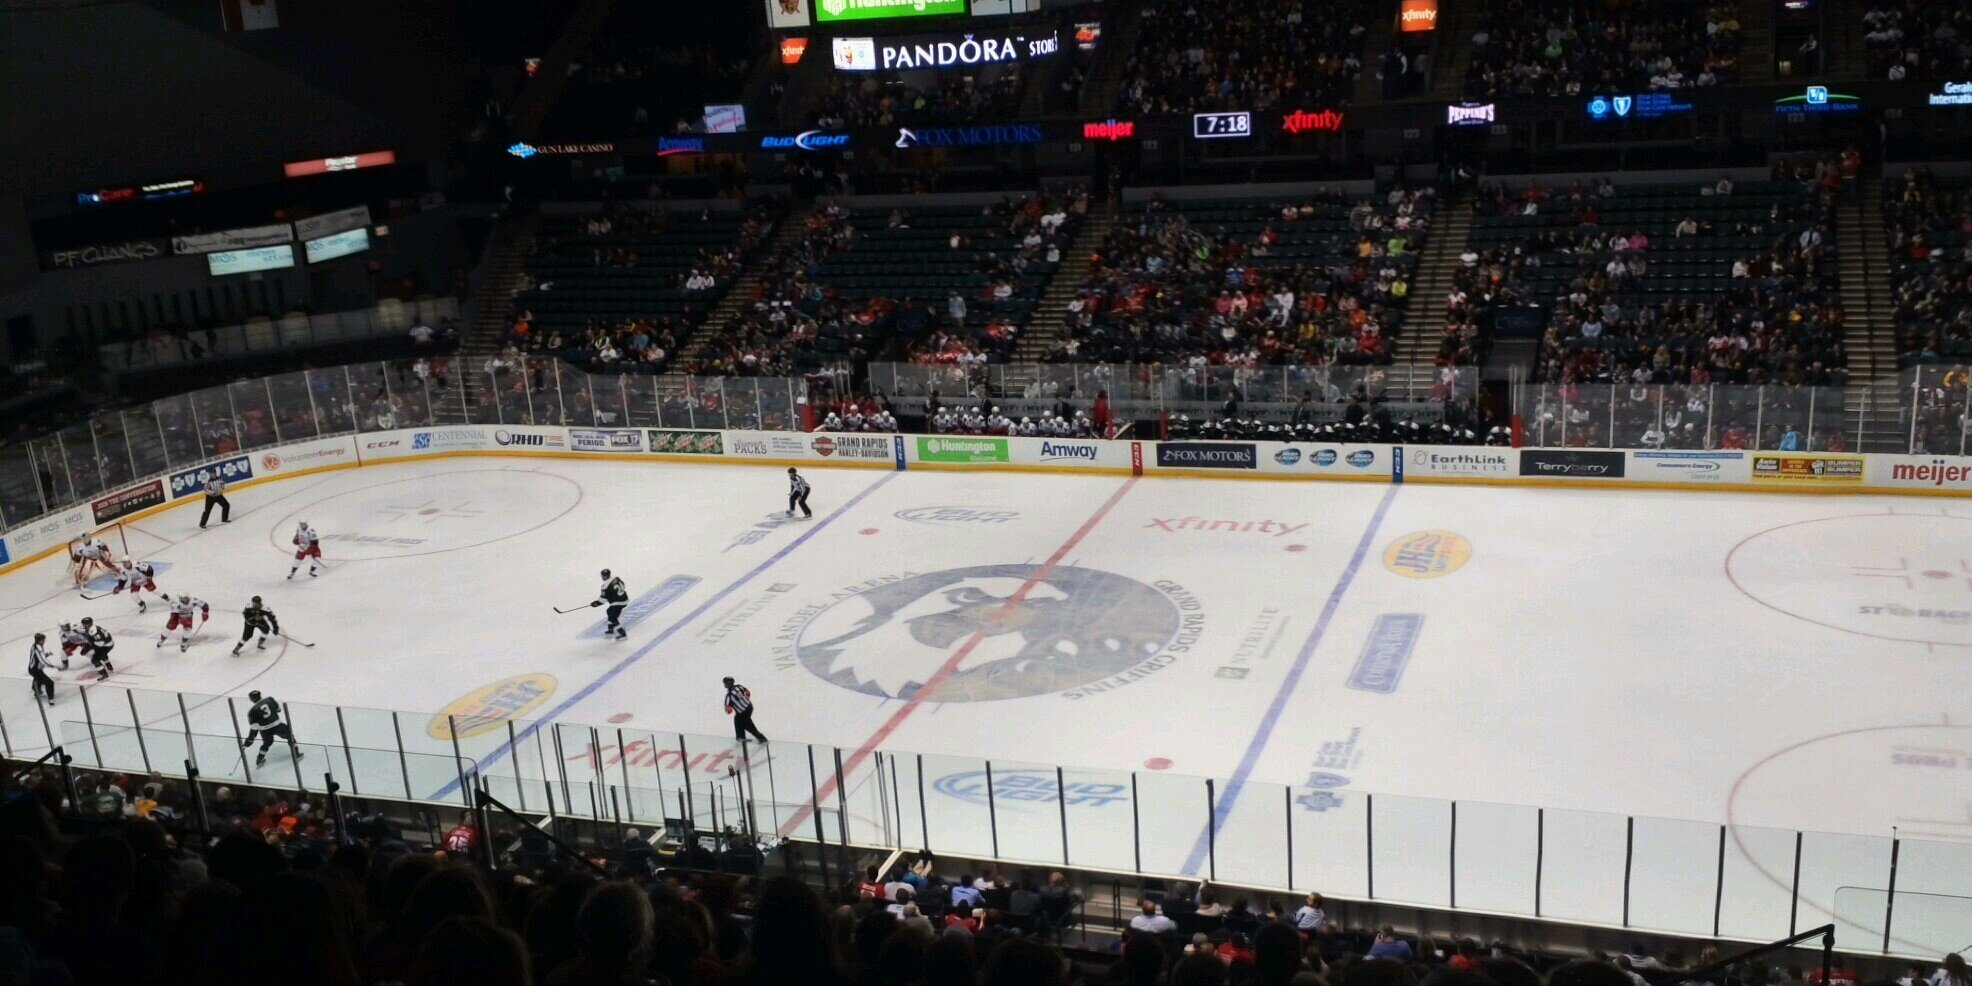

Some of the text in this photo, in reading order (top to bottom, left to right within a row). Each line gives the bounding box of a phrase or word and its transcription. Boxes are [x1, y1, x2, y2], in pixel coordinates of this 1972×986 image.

[1402, 9, 1437, 23] xfinity
[1207, 116, 1248, 132] 7:18
[1282, 109, 1343, 133] xfinity
[915, 124, 1042, 146] FOX MOTORS
[1084, 119, 1134, 141] meijer
[761, 134, 849, 147] BUD LIGHT
[432, 429, 487, 441] CENTENNIAL
[511, 433, 543, 446] RHD
[837, 436, 860, 448] GRAND
[861, 437, 888, 448] RAPIDS
[366, 440, 399, 449] CCM
[941, 440, 996, 454] Huntington
[1041, 441, 1097, 460] Amway
[838, 449, 889, 458] HARLEY-DAVIDSON
[1174, 449, 1251, 462] FOX MOTORS
[1431, 453, 1506, 465] EarthLink
[1535, 461, 1609, 473] Terryberry
[1892, 459, 1971, 485] meijer
[1142, 515, 1311, 537] xfinity
[771, 570, 920, 671] VAN ANDEL ARENA
[1061, 579, 1205, 700] GRAND RAPIDS GRIFFINS
[260, 703, 272, 719] 3
